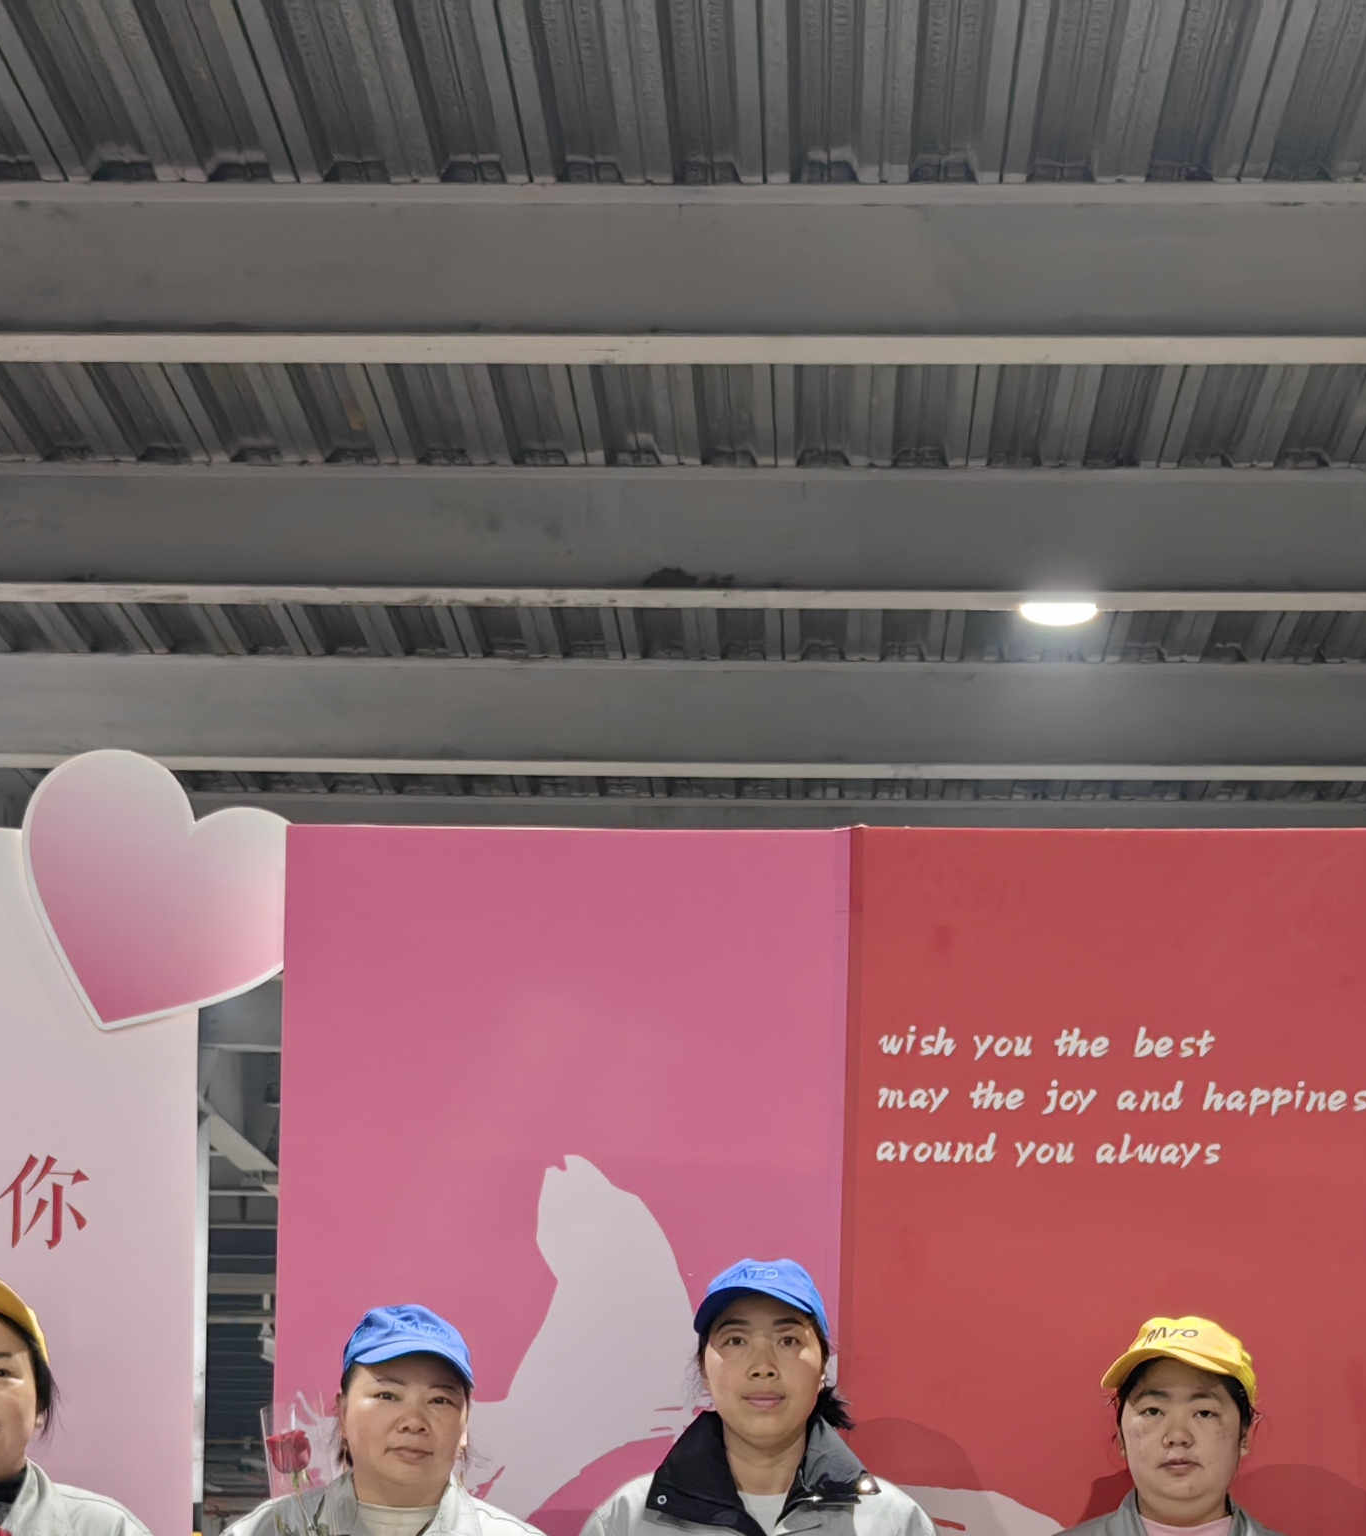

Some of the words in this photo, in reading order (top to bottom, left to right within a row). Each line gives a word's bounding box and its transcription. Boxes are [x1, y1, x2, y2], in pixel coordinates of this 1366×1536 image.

[878, 1025, 956, 1057] wish
[974, 1031, 1032, 1060] you
[1054, 1027, 1110, 1058] the
[1134, 1027, 1216, 1058] best
[877, 1087, 949, 1113] may
[969, 1080, 1025, 1111] the
[1042, 1079, 1096, 1115] joy
[1117, 1080, 1184, 1111] and
[876, 1132, 997, 1164] around
[1015, 1141, 1076, 1167] you
[1096, 1133, 1221, 1168] always
